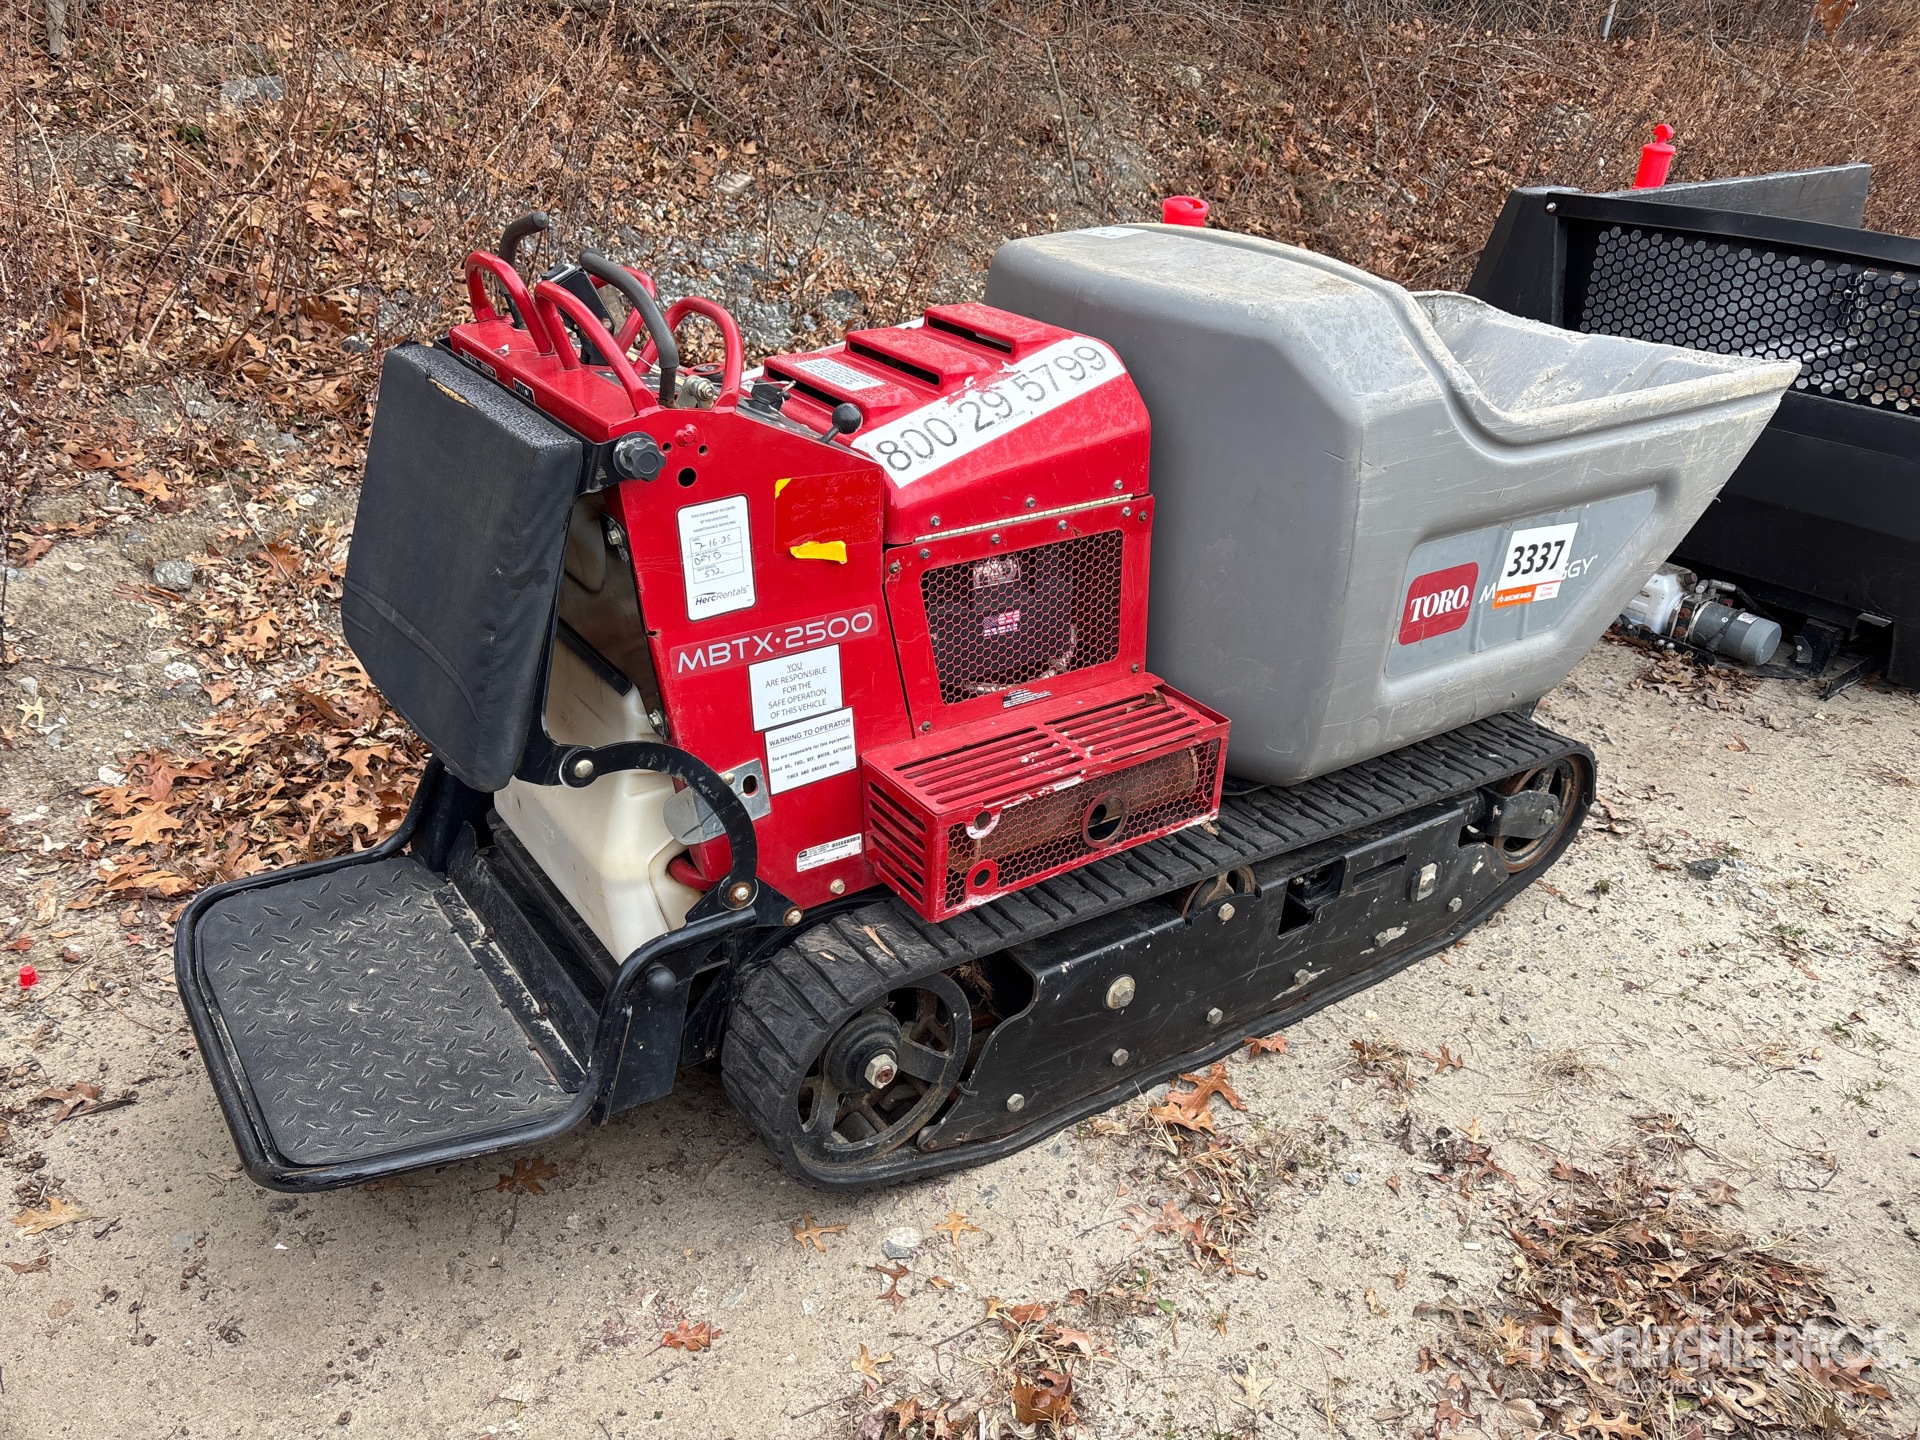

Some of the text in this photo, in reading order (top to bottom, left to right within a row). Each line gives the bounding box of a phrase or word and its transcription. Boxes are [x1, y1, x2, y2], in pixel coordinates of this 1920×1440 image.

[876, 346, 1107, 472] 800 29 5799
[1506, 539, 1567, 578] 3337
[1409, 585, 1469, 623] TORO
[766, 666, 827, 688] ARE RESPONSIBLE
[786, 662, 803, 672] YOU
[782, 681, 812, 694] FOR THE
[768, 688, 827, 709] SAFE OPERATION
[781, 706, 797, 715] THIS
[798, 698, 826, 712] VEHICLE
[769, 732, 802, 746] WARNING
[814, 718, 851, 733] OPERATOR
[789, 746, 812, 757] responsible
